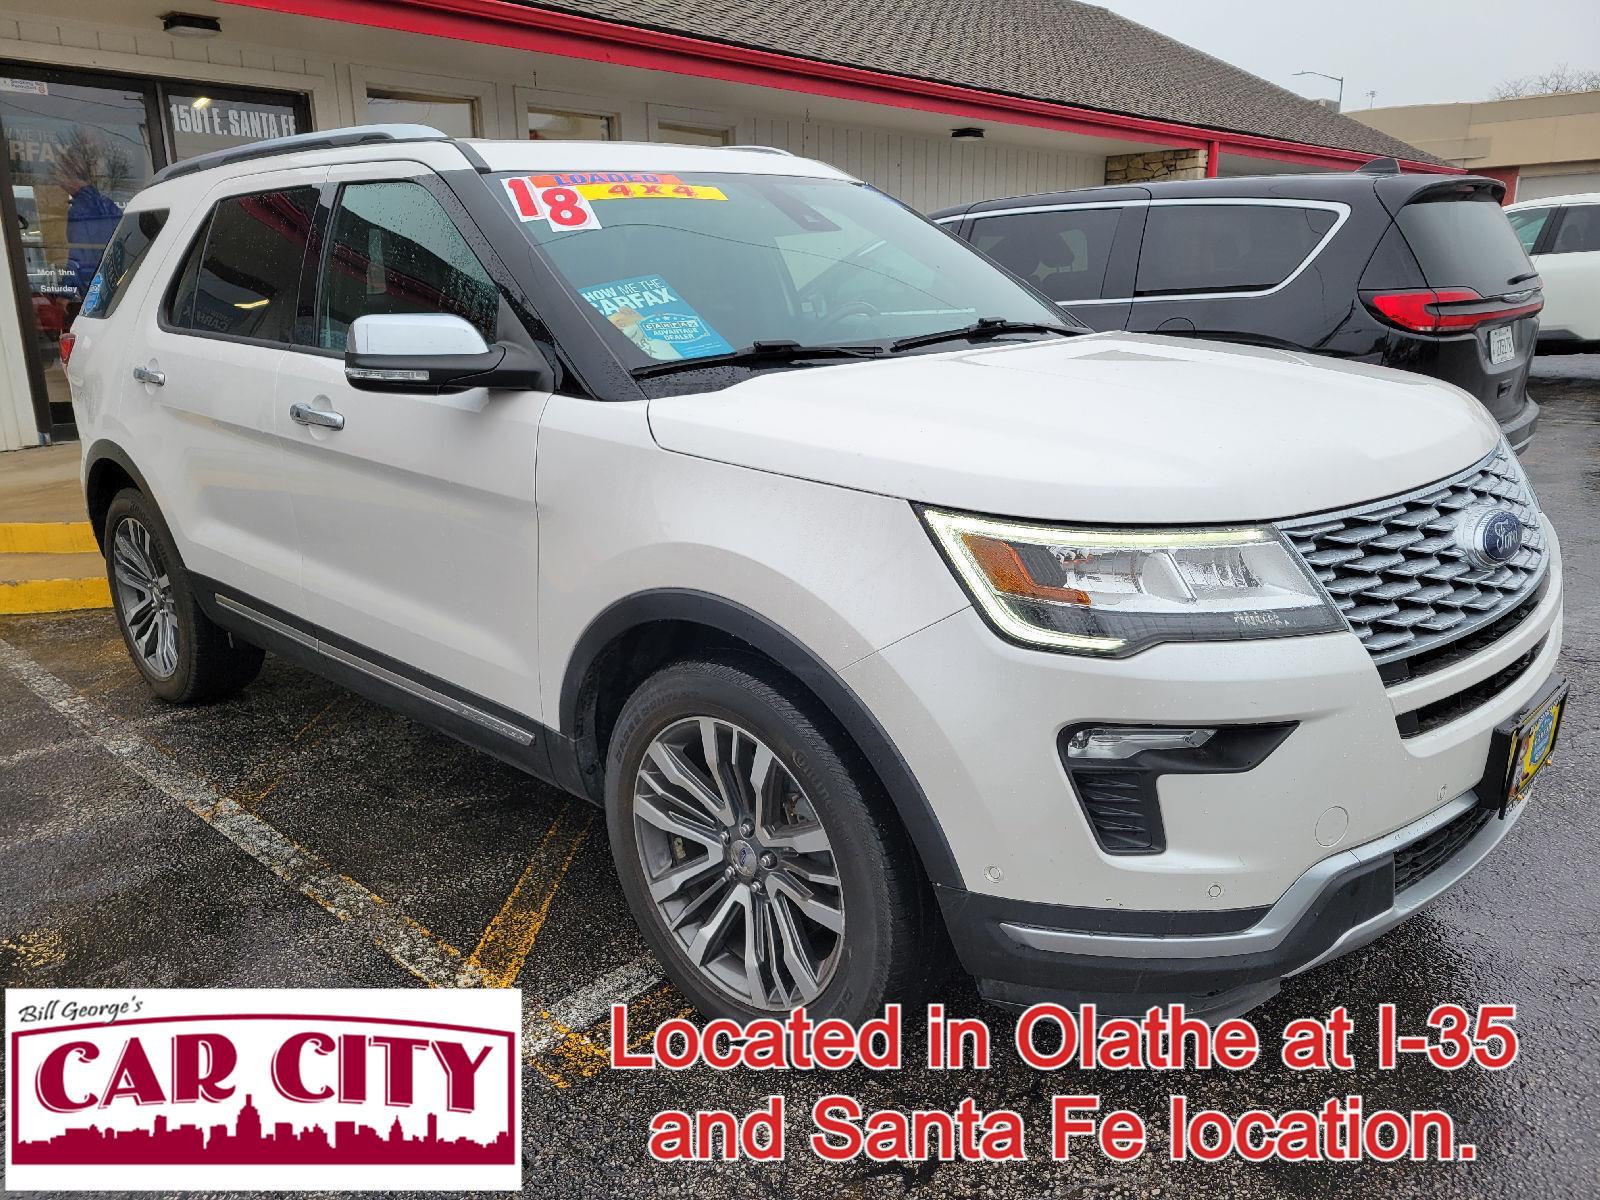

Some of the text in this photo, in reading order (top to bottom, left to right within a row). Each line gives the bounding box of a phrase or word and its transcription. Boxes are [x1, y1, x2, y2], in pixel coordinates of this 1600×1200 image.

[170, 103, 297, 138] 1501 E. SANTA FE
[554, 174, 659, 186] LOADED
[508, 178, 592, 227] 18
[37, 268, 75, 277] Mon thru
[40, 284, 78, 294] Saturday
[582, 278, 665, 303] HOW ME THE
[653, 328, 700, 337] ADVANTAGE
[664, 333, 696, 342] DEALER
[1494, 518, 1518, 554] Ford
